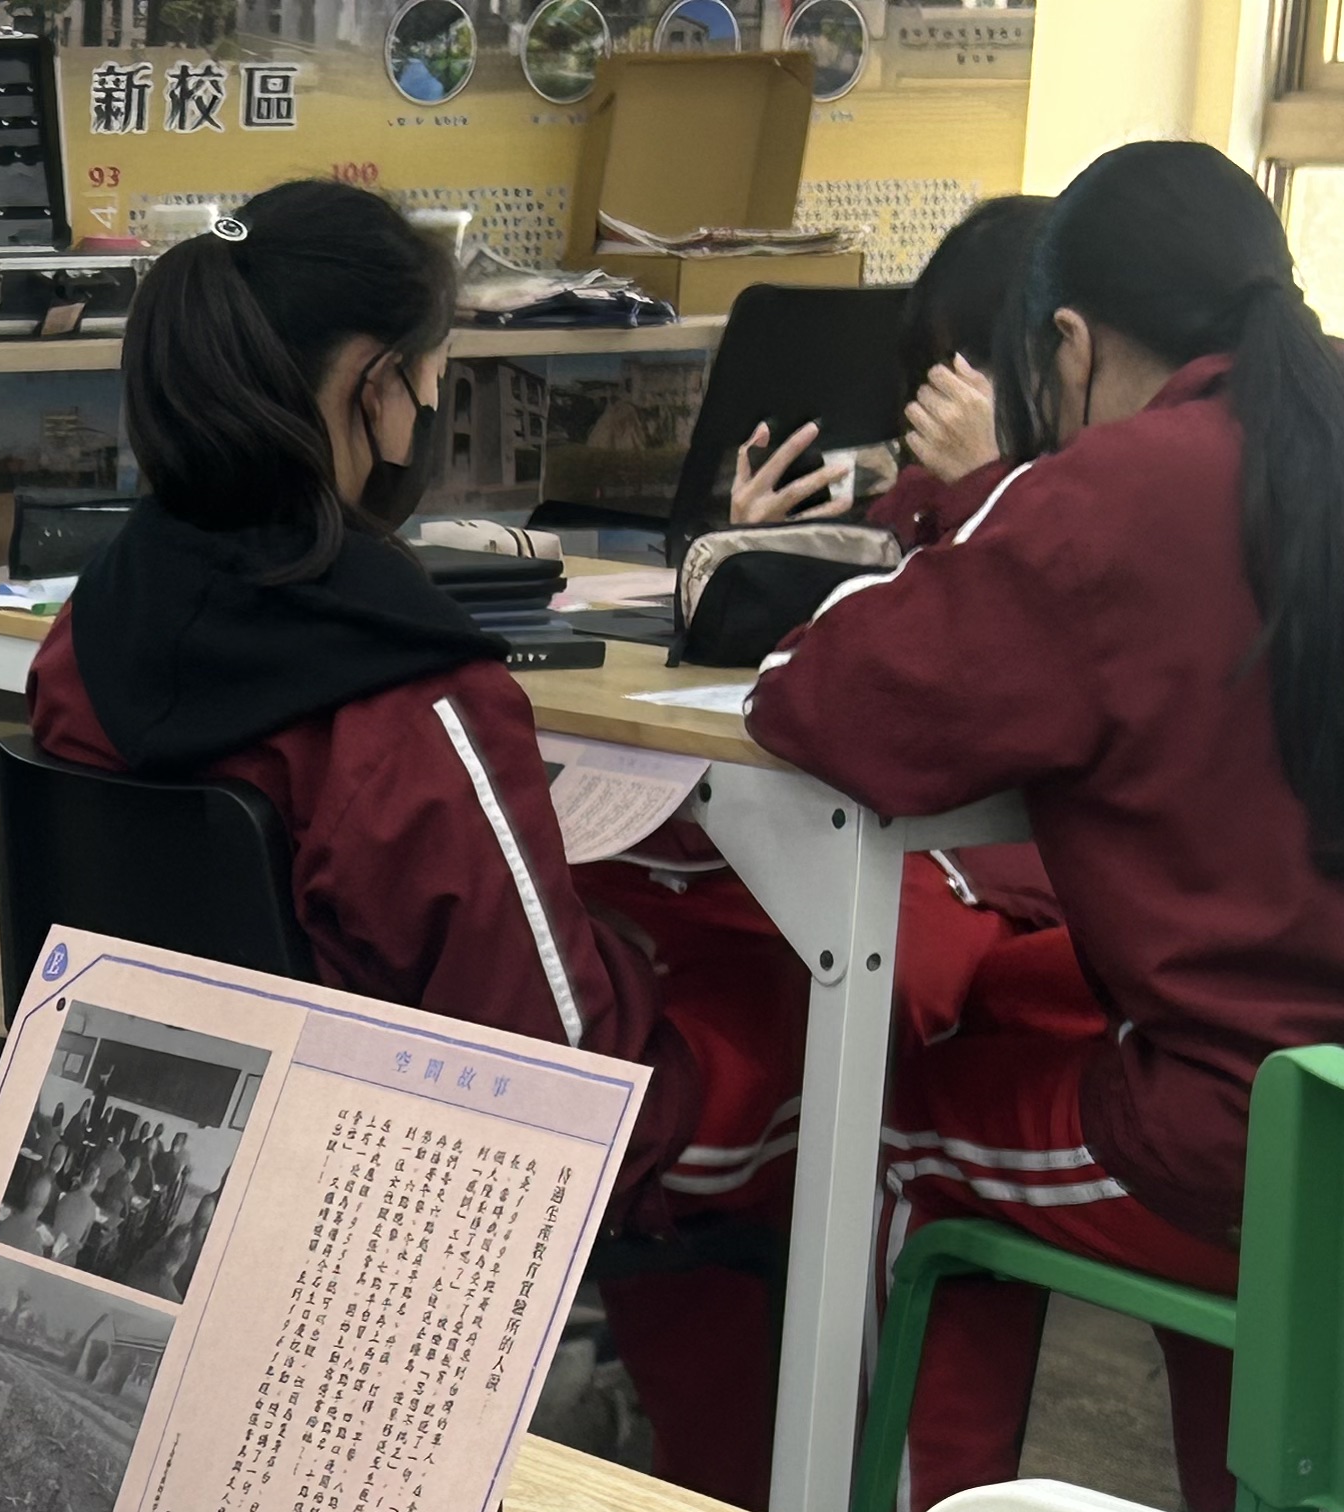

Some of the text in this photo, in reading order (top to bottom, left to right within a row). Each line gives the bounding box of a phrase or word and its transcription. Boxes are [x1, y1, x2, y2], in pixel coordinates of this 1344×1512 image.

[91, 63, 300, 133] 新校區
[88, 167, 120, 188] 93
